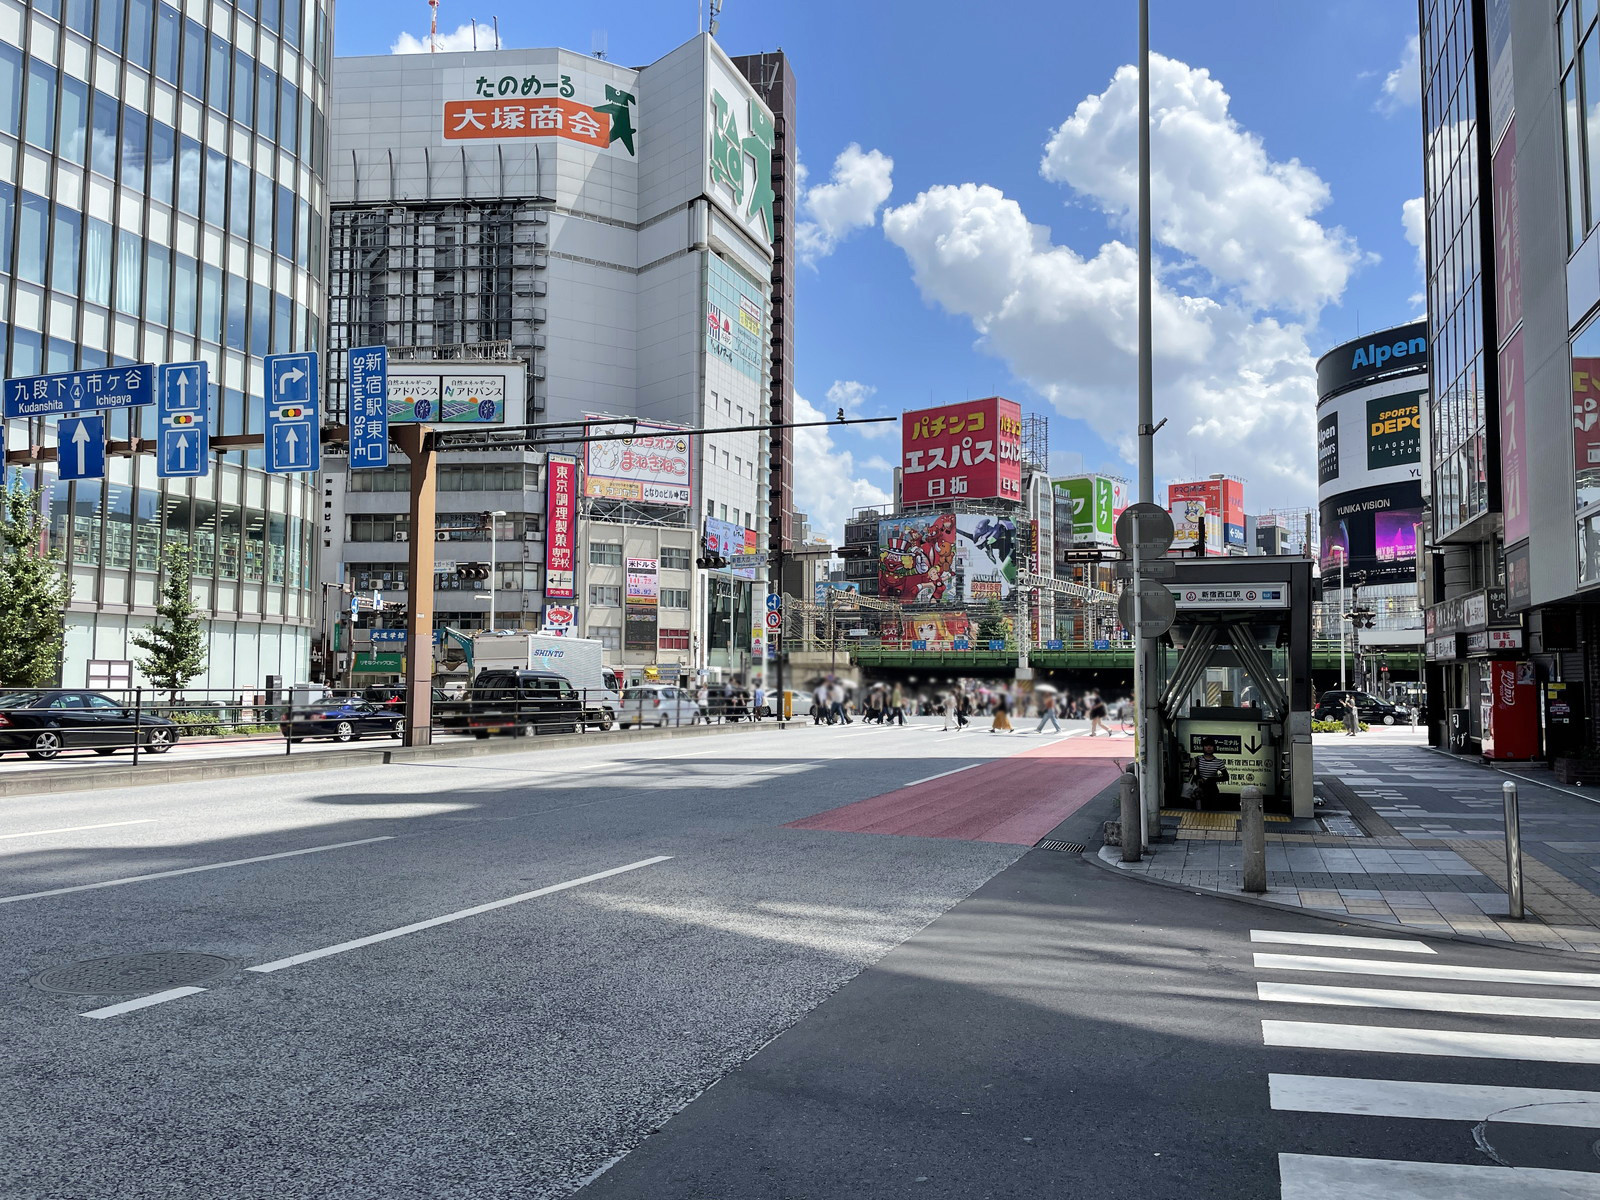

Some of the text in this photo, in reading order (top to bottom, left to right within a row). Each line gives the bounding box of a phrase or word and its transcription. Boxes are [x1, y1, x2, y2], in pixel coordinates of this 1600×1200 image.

[476, 75, 575, 98] たのめーる
[452, 105, 602, 139] 大塚商会
[1351, 337, 1426, 370] Alpen
[14, 377, 68, 403] 九段下
[74, 386, 80, 398] 4
[353, 356, 366, 413] Shinjuku
[393, 387, 438, 396] アドバンス
[457, 387, 502, 396] アドバンス
[18, 393, 132, 414] Kudanshita Ichigaya
[365, 351, 384, 462] 新宿駅東口
[1379, 405, 1419, 420] SPORTS
[912, 412, 985, 440] パチンコ
[1000, 414, 1021, 437] パチンコ
[620, 450, 687, 475] まねきねこ
[904, 436, 996, 475] エスパス
[644, 488, 673, 499] となりのビル
[1100, 480, 1108, 525] レイク
[555, 465, 569, 547] 東京調理製菓
[1336, 498, 1391, 516] YUNIKA VISION
[1493, 632, 1511, 640] 回転
[1499, 640, 1515, 648] 寿司
[534, 649, 564, 658] SHINTO
